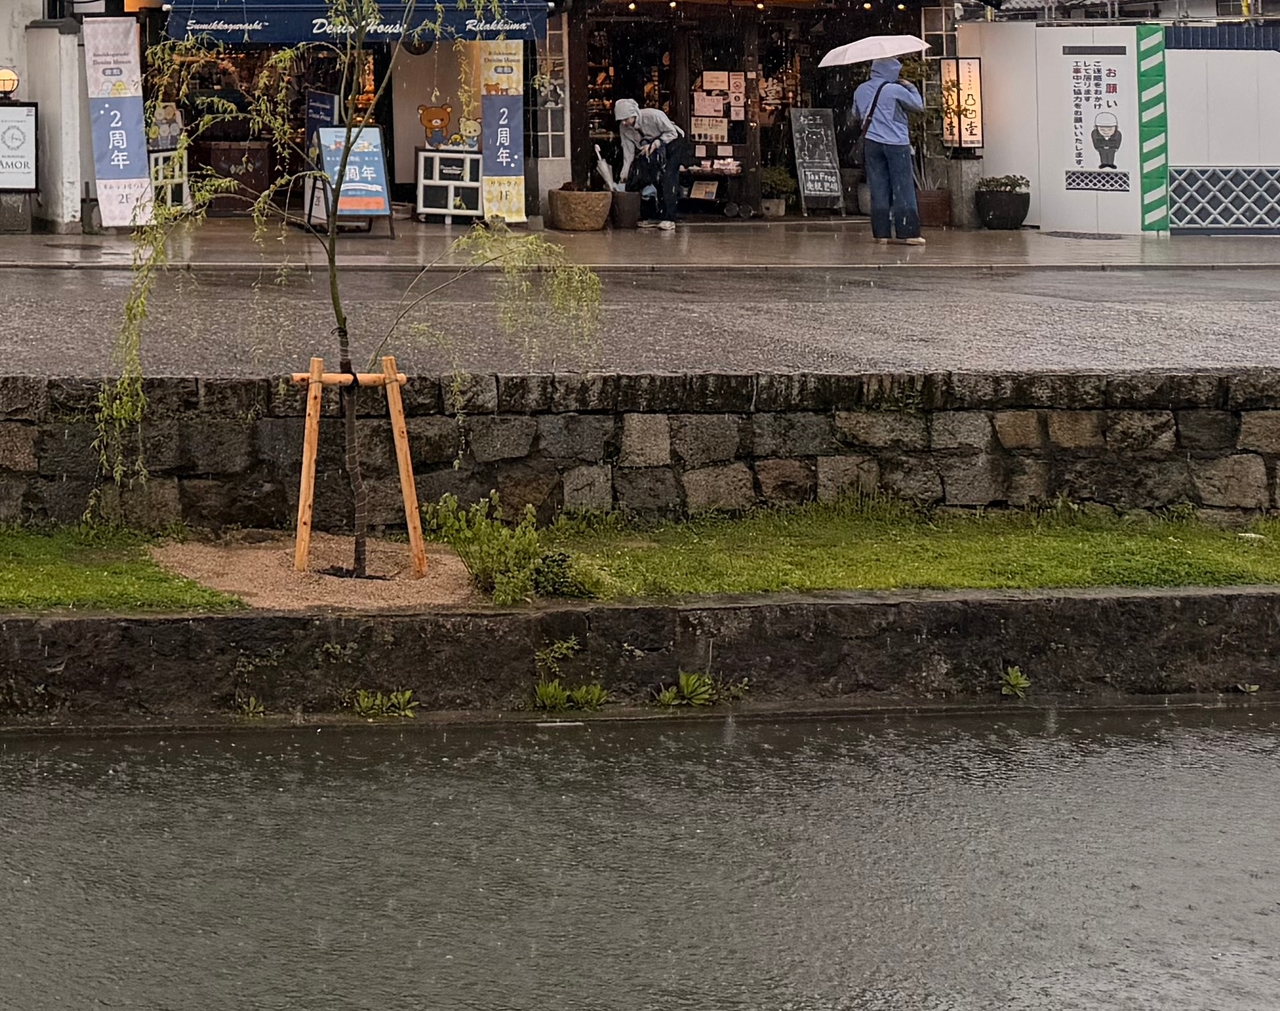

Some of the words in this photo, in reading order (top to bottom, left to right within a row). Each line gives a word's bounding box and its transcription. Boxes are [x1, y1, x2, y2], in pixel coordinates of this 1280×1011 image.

[465, 19, 528, 32] Rilakkuma
[1105, 68, 1118, 109] お願い
[108, 110, 130, 170] 2周年
[496, 107, 511, 167] 2周年
